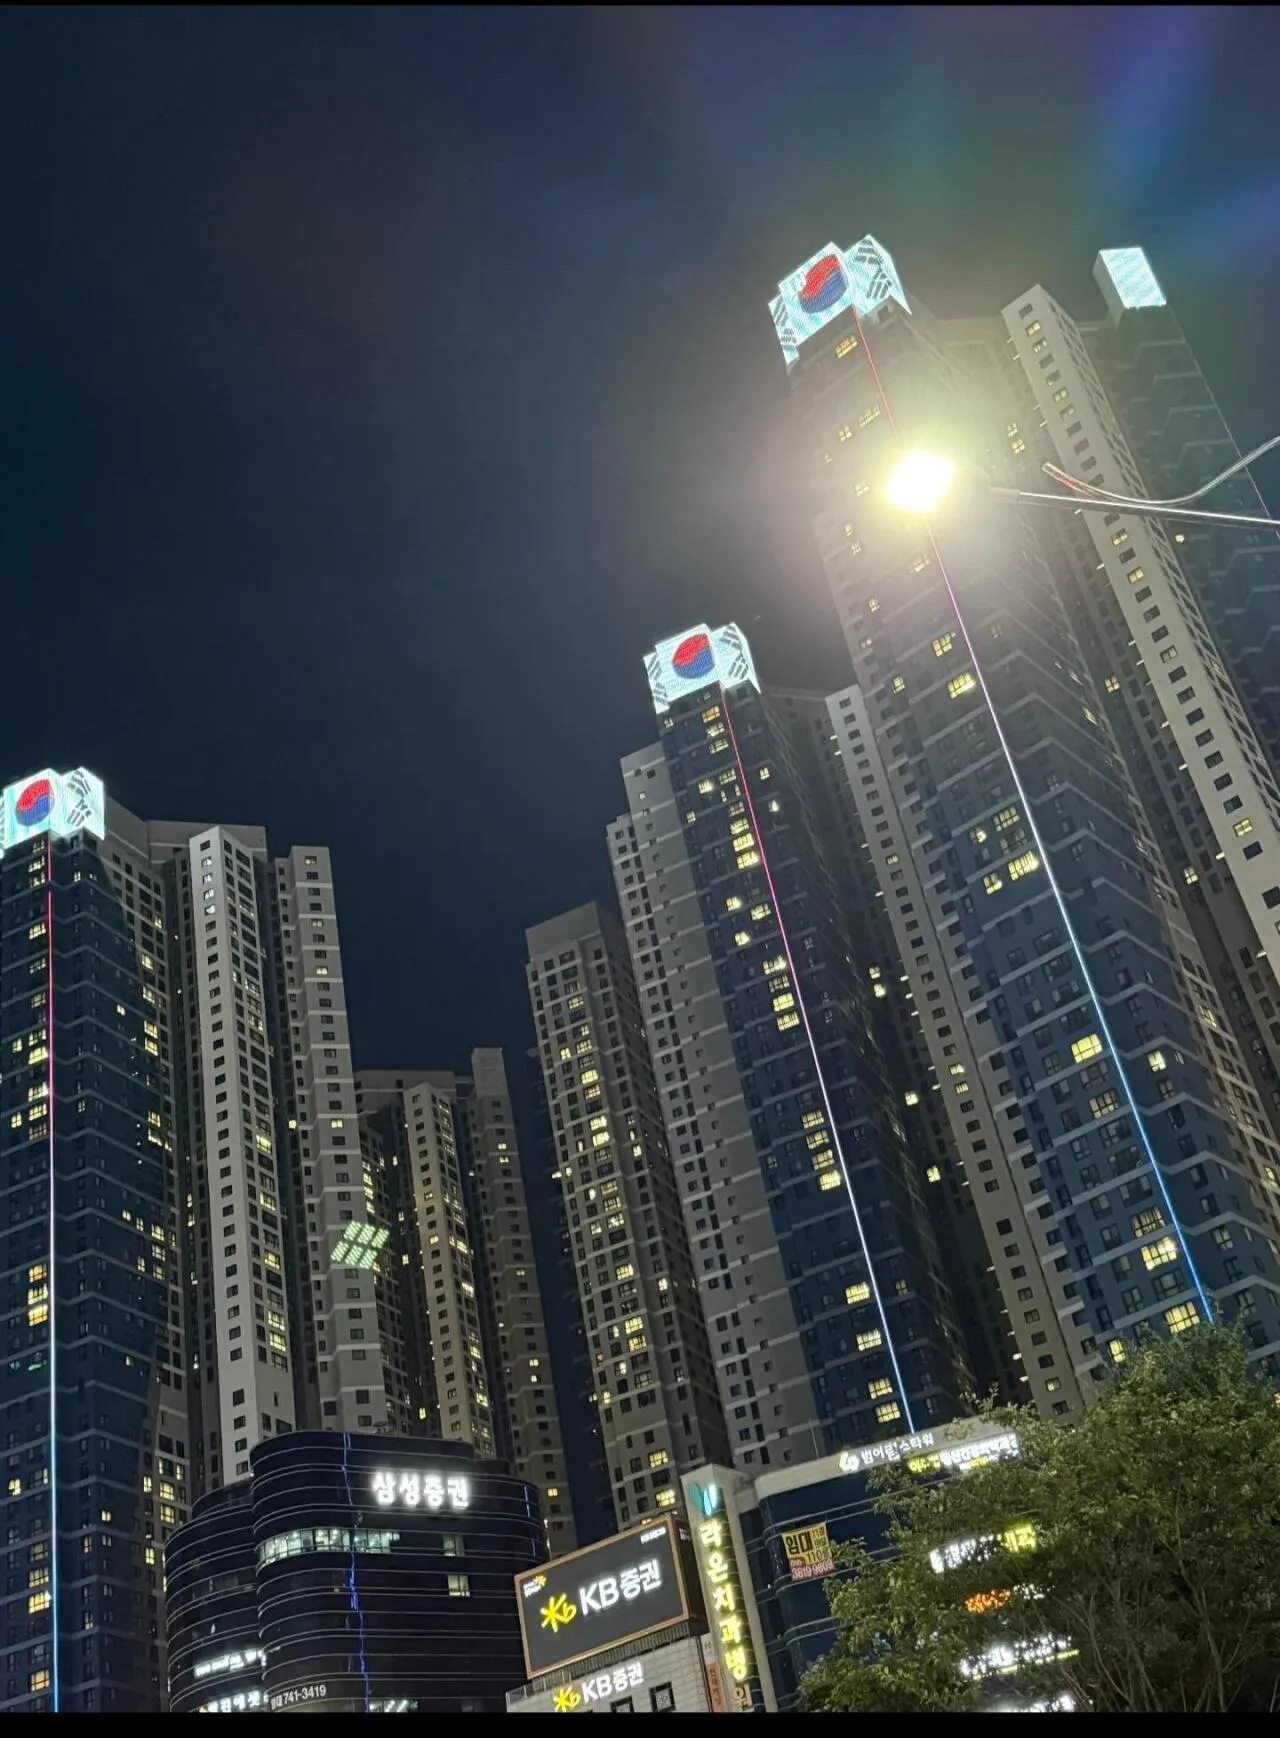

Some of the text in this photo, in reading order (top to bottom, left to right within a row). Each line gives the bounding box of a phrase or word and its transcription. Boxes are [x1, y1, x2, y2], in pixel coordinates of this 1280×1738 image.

[372, 1470, 471, 1509] 삼성증권
[785, 1530, 813, 1555] 임대
[578, 1557, 663, 1616] KB증권
[699, 1520, 752, 1711] 라온치과병원
[284, 1684, 327, 1705] 741-3419
[581, 1660, 644, 1705] KB증권
